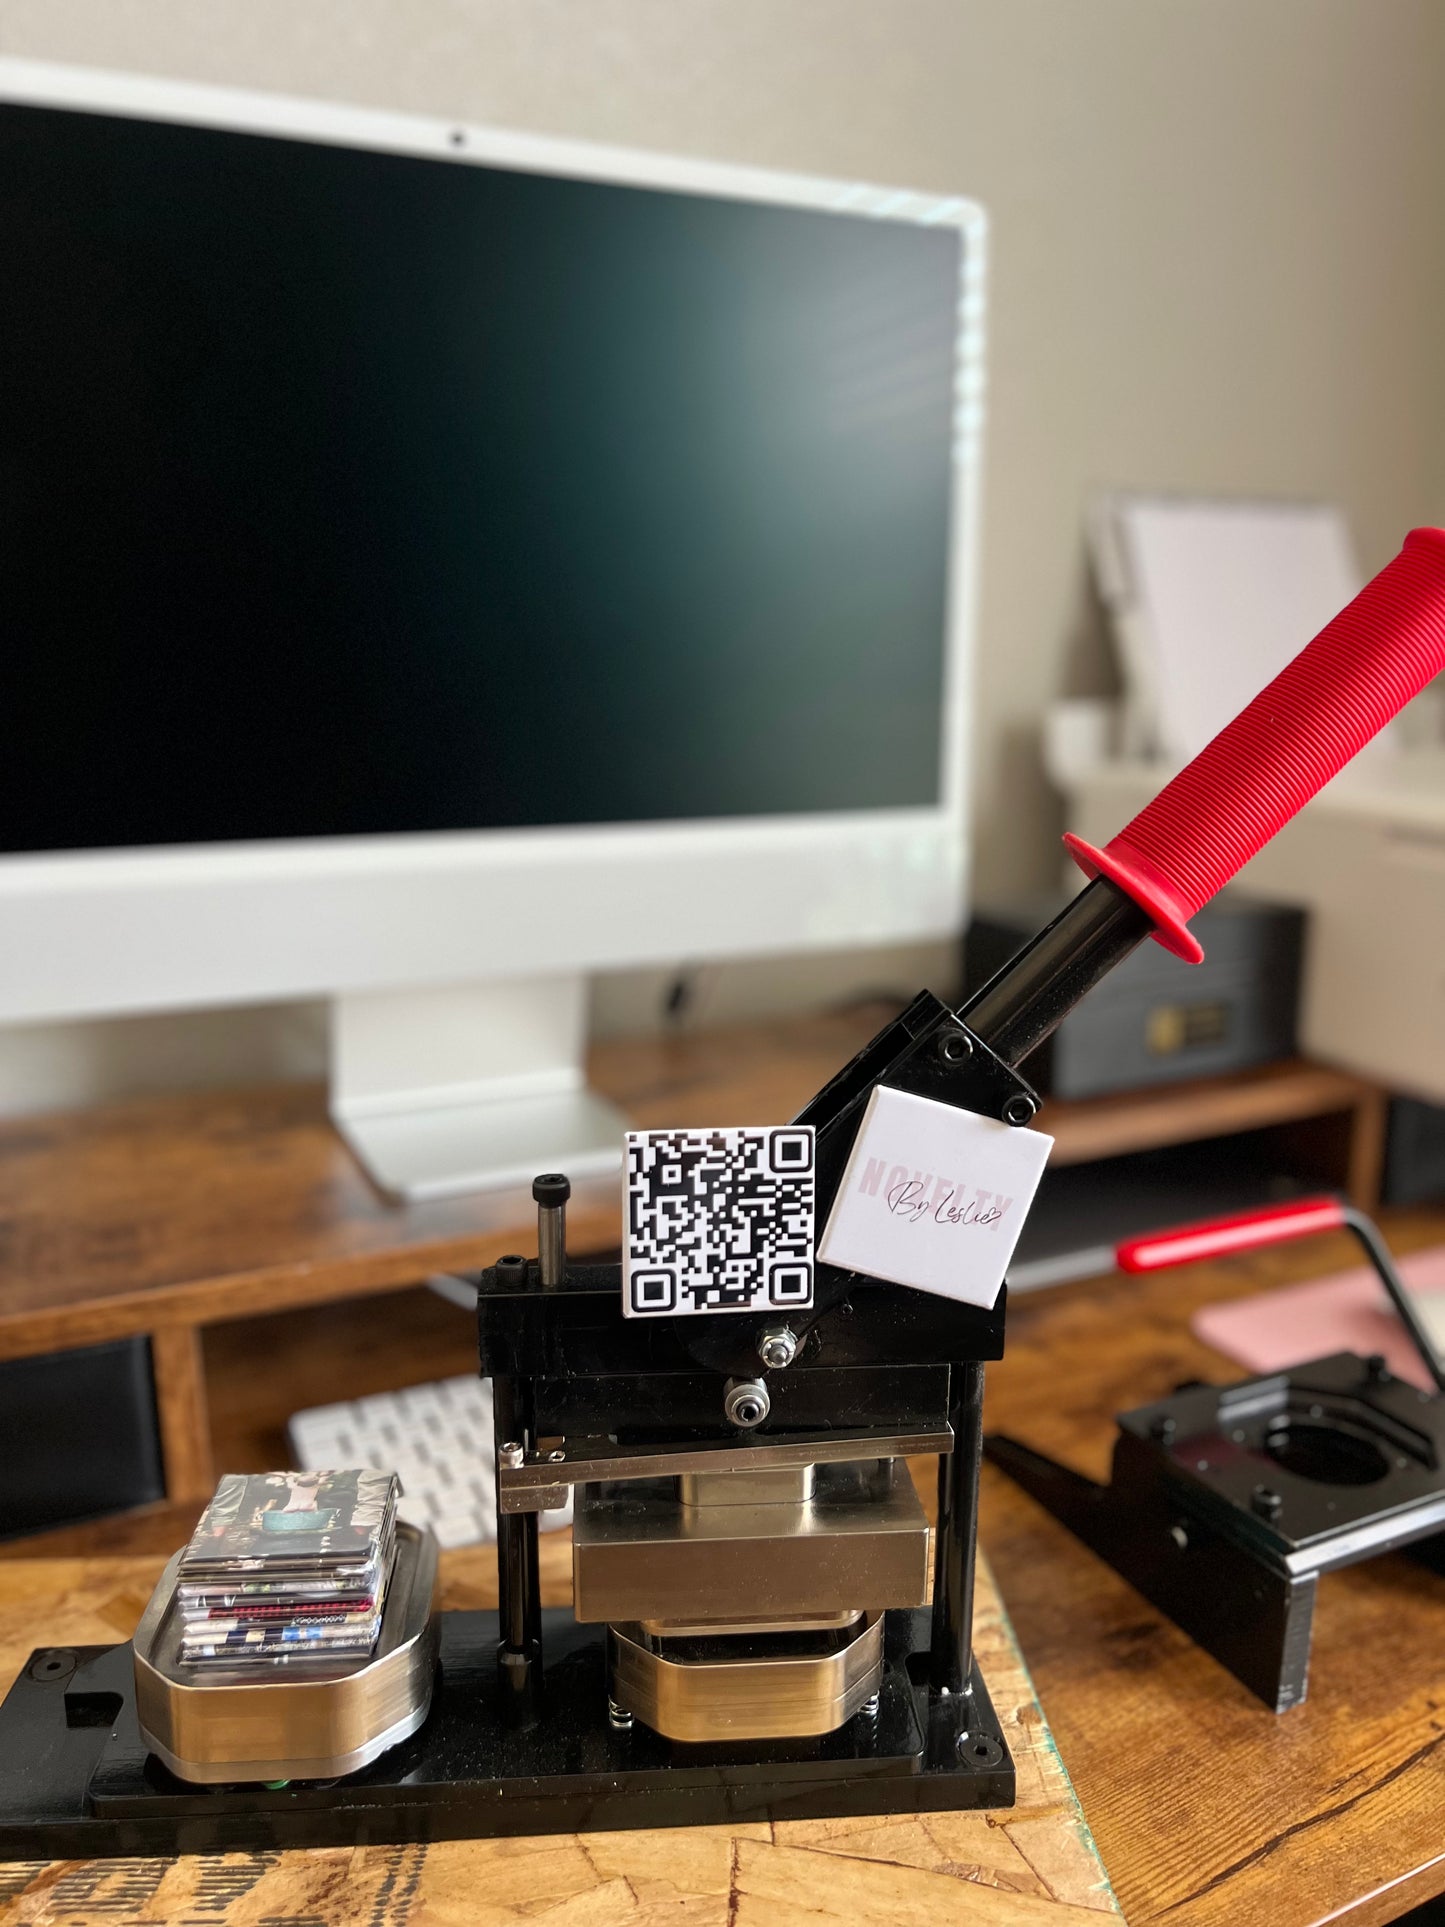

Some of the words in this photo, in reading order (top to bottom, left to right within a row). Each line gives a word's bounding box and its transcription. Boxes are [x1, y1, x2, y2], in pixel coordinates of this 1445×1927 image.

[859, 1158, 1014, 1231] NOVELTY
[888, 1181, 930, 1222] By
[934, 1190, 996, 1224] Leslie
